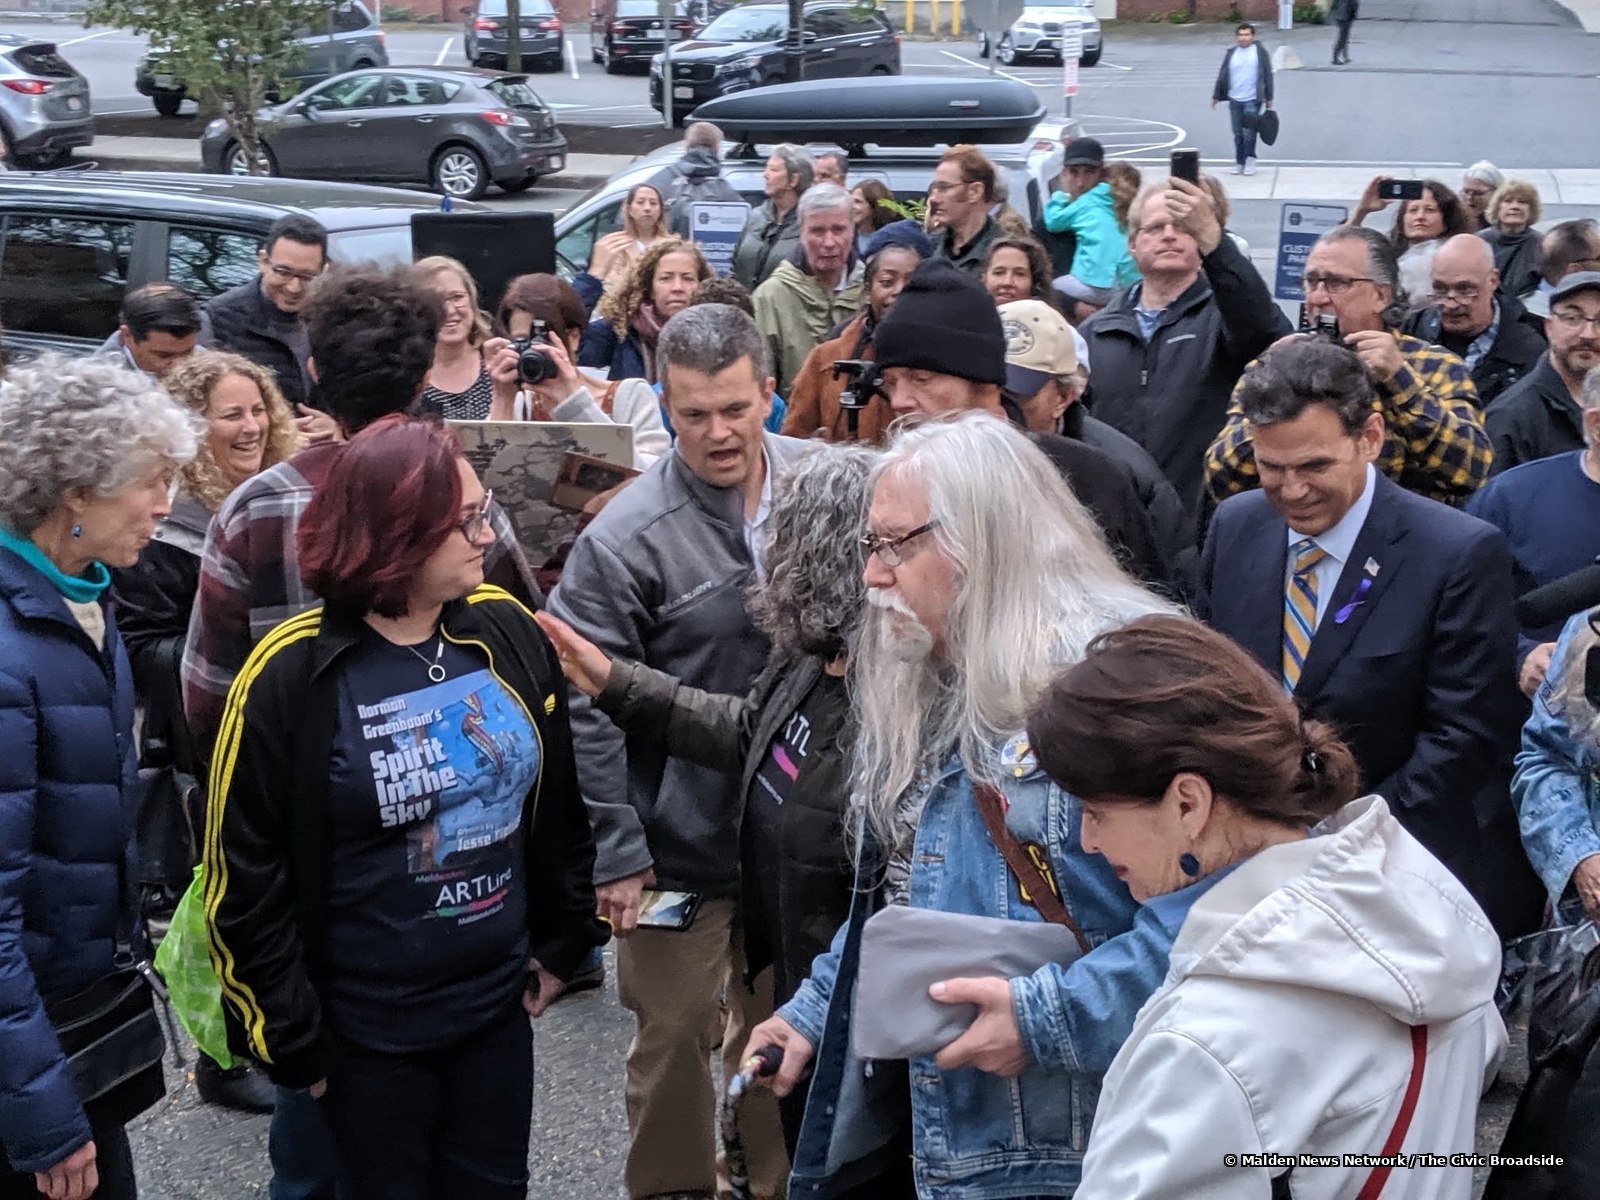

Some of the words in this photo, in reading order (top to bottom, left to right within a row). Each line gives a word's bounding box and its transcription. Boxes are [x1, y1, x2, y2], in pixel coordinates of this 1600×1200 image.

[357, 699, 407, 719] Norman
[369, 736, 447, 783] Spirit
[375, 778, 407, 807] In
[406, 765, 458, 798] The
[380, 798, 432, 828] Sky
